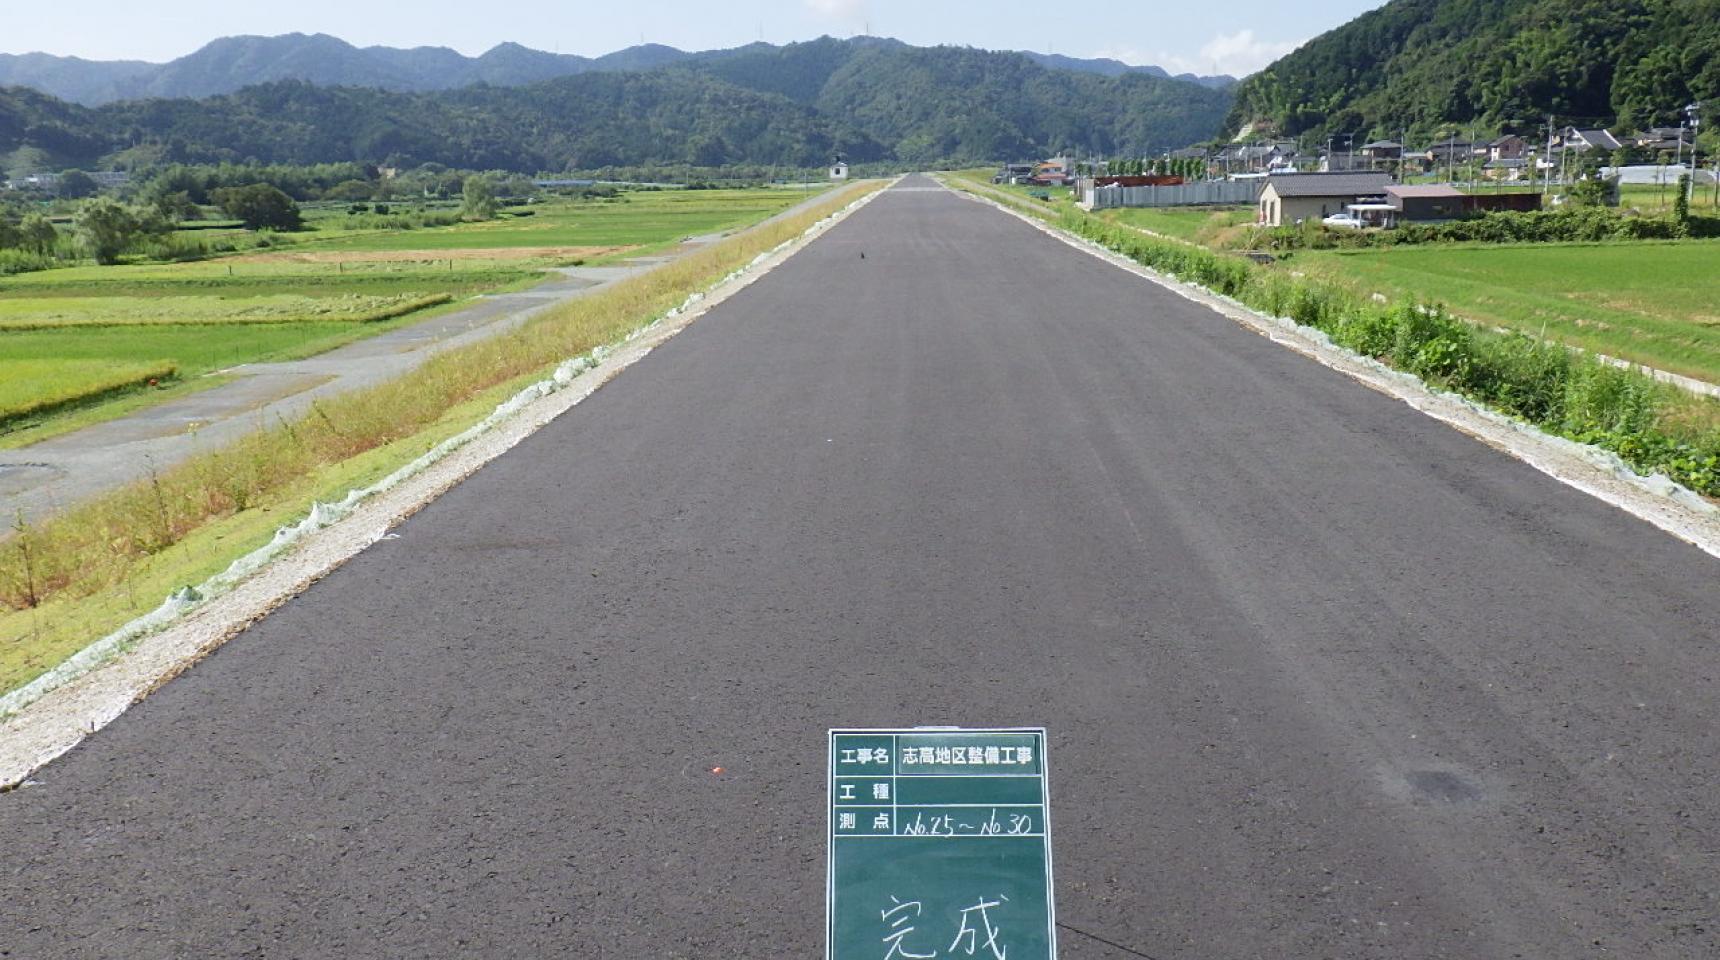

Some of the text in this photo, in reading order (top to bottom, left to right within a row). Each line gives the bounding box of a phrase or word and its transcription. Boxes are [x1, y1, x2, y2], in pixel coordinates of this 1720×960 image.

[841, 748, 889, 764] 工事名
[902, 746, 1033, 765] 志高地区整備工事
[839, 783, 889, 800] 工種
[839, 812, 889, 829] 測点
[881, 893, 1010, 960] 完成
